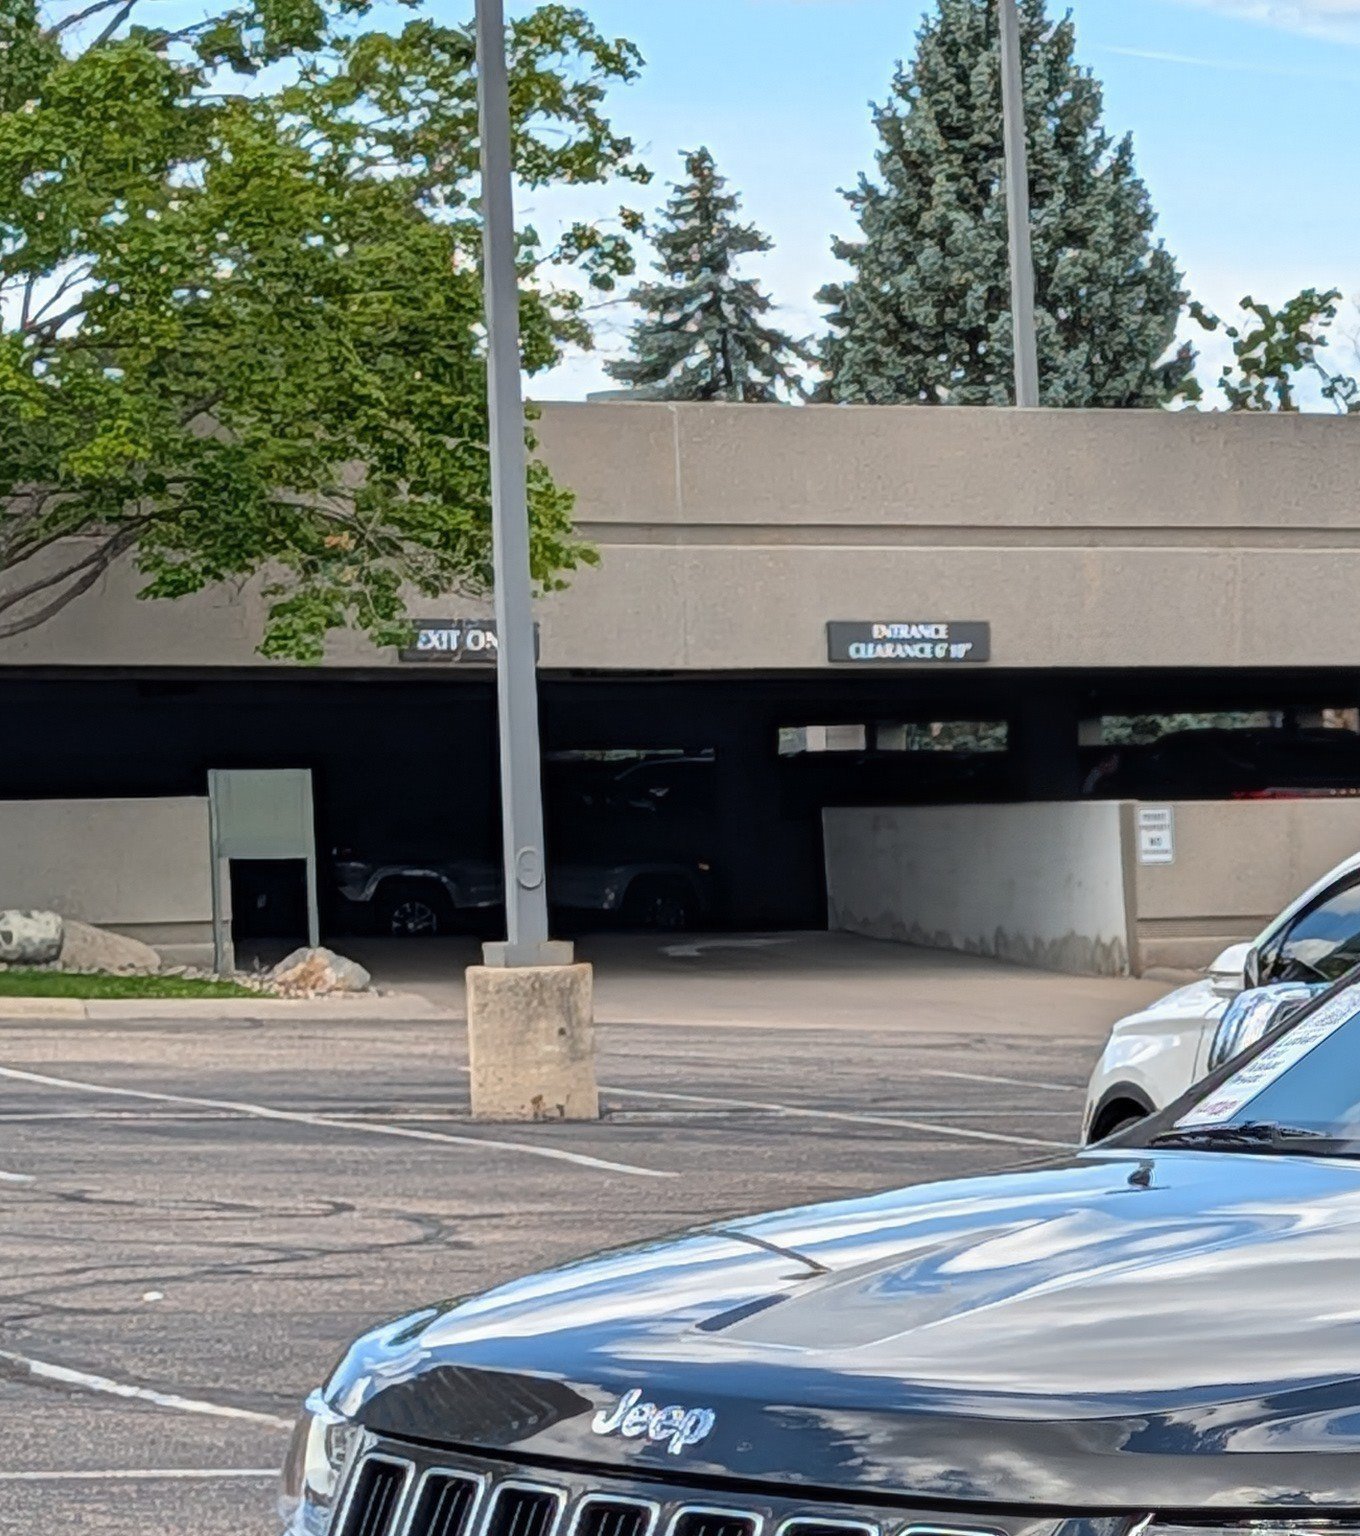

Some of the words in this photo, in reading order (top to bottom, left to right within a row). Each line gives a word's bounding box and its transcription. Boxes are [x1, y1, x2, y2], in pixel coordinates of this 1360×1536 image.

[417, 629, 460, 651] EXIT
[466, 629, 498, 651] ON
[872, 624, 948, 639] ENTRANCE
[849, 642, 933, 658] CLEARANCE
[592, 1388, 716, 1455] Jeep
